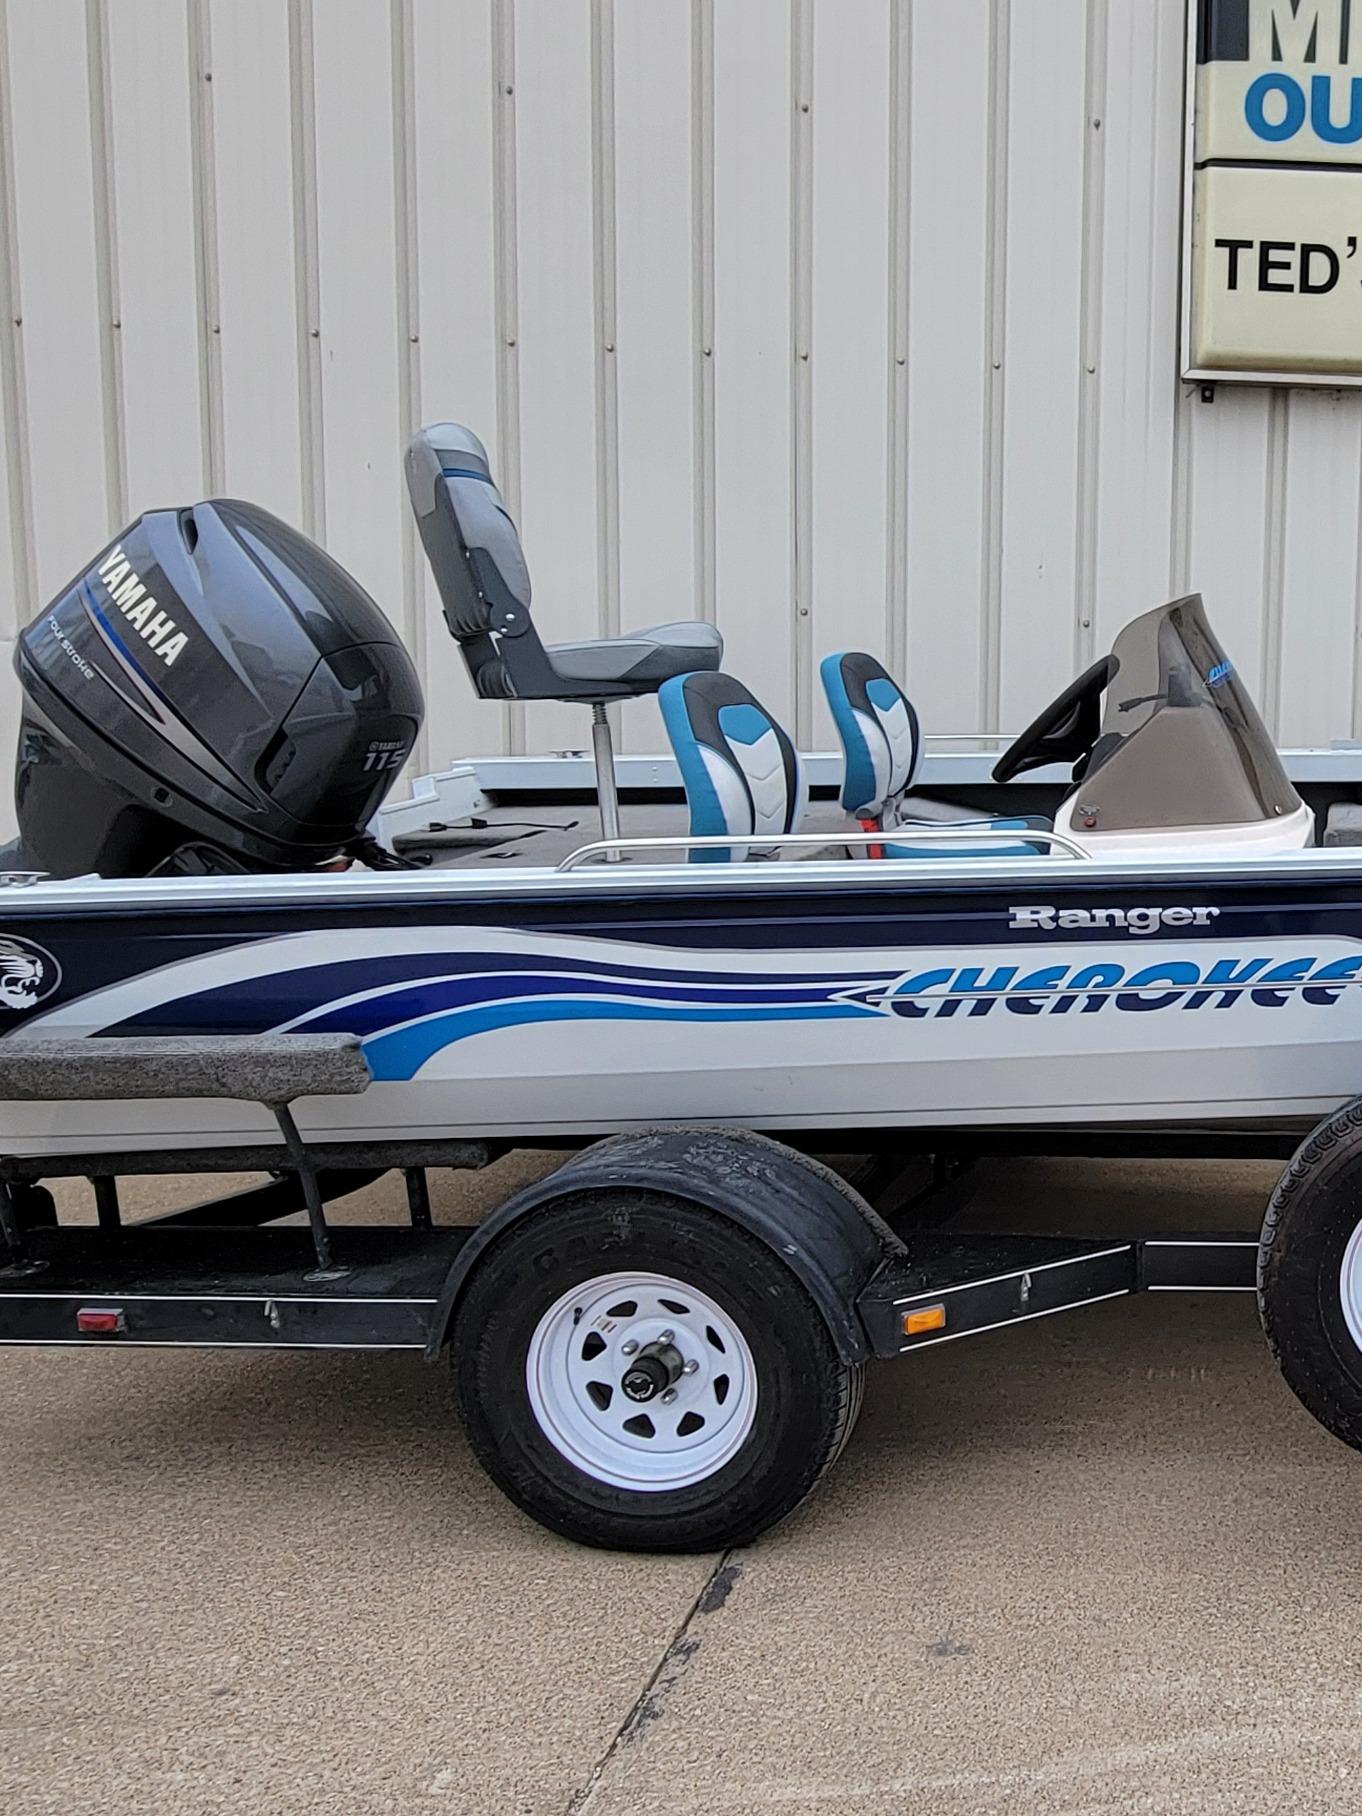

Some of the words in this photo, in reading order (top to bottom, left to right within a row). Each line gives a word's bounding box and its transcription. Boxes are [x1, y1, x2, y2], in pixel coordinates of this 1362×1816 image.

[98, 544, 189, 666] YAMAHA
[363, 748, 406, 771] 115
[1008, 905, 1220, 934] Ranger
